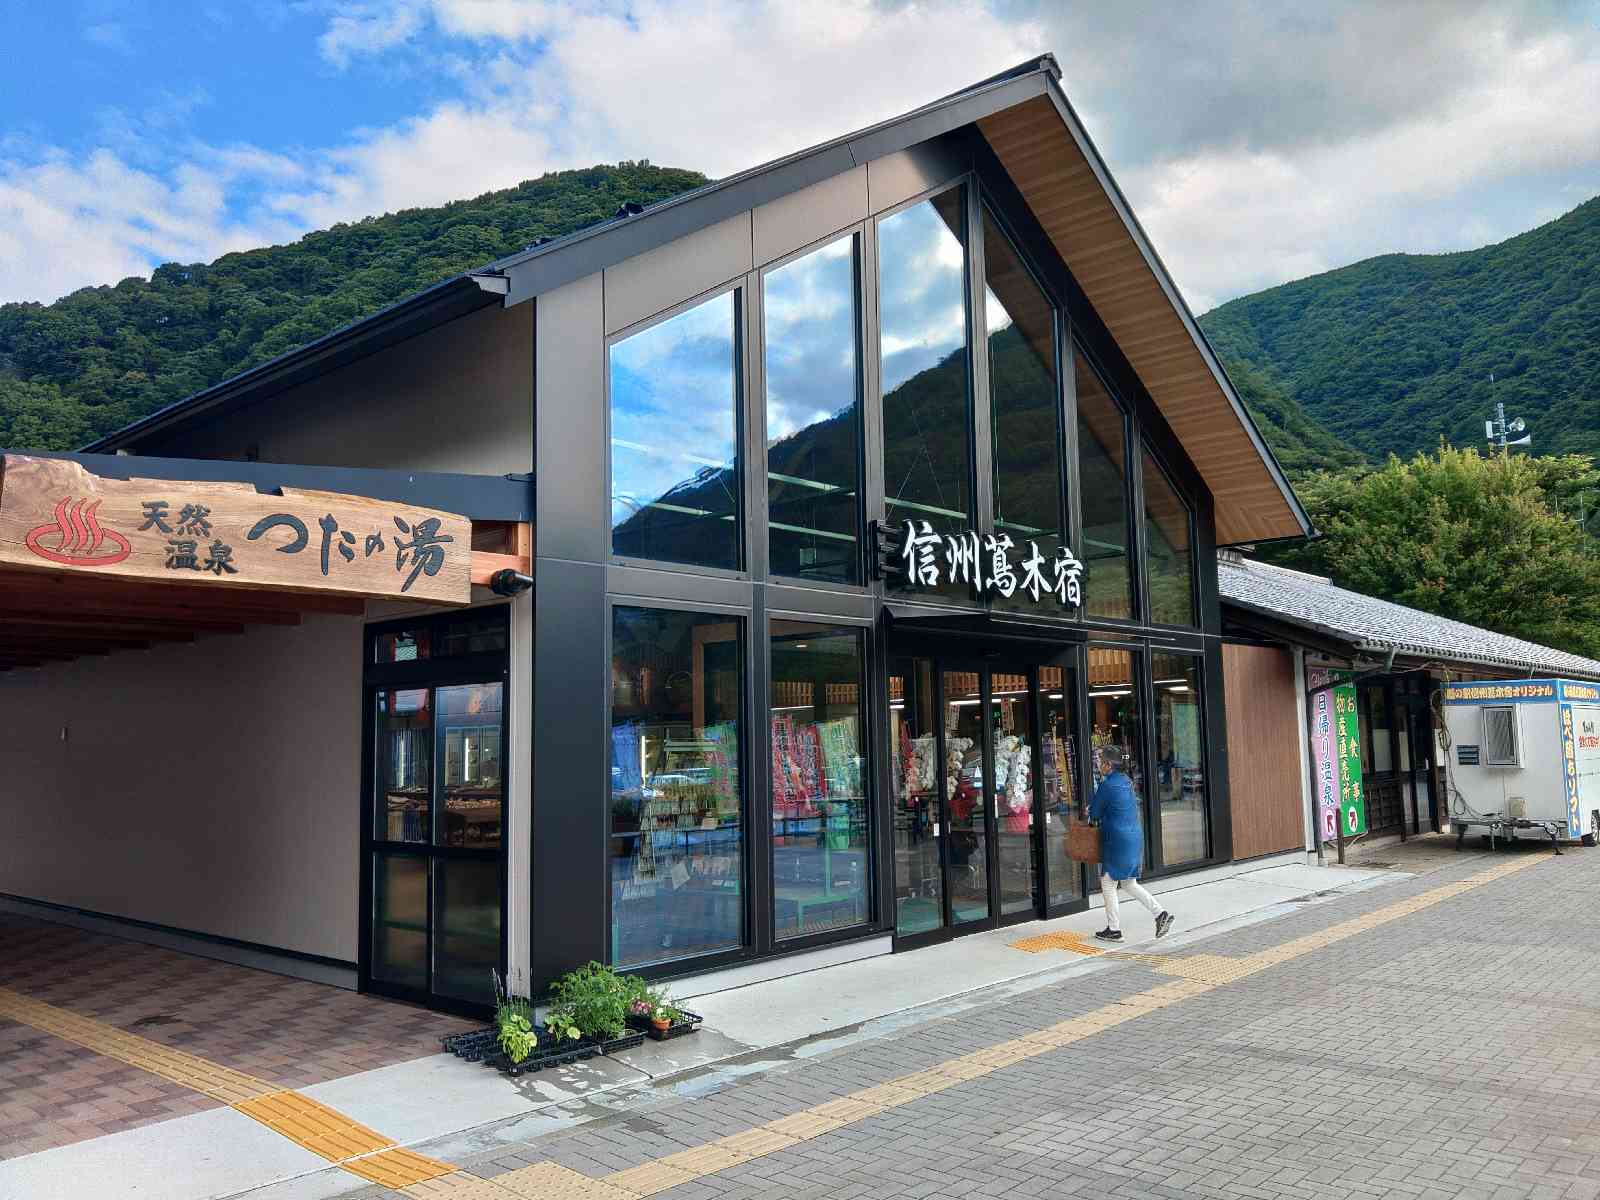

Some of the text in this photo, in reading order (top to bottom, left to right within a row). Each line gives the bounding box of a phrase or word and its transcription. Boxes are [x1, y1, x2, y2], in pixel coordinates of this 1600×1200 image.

[138, 501, 215, 537] 天然
[165, 539, 239, 575] 温泉
[246, 513, 453, 592] つたの湯
[902, 518, 1083, 607] 信州蔦木宿
[1317, 693, 1336, 807] 日帰り温泉
[1347, 695, 1361, 802] お食事
